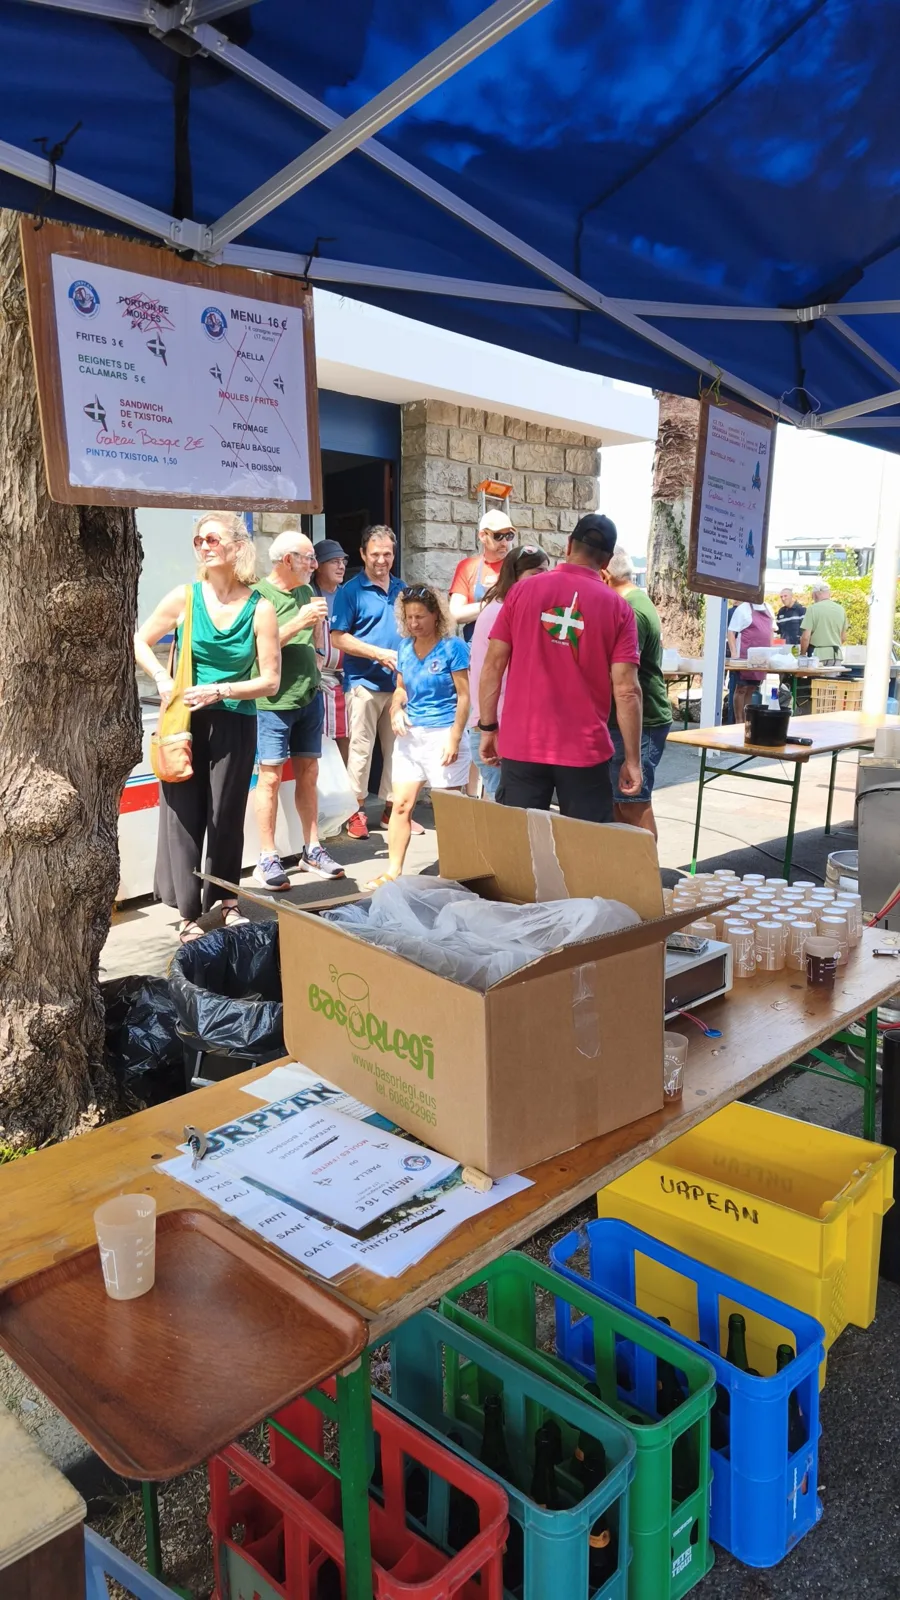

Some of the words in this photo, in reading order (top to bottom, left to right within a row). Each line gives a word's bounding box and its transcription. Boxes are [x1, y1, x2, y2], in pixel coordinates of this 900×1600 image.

[118, 296, 156, 311] PORTION
[157, 305, 170, 314] DE
[126, 308, 161, 323] MOULES
[230, 308, 262, 324] MENU
[268, 317, 279, 328] 16
[281, 320, 288, 330] €
[76, 331, 107, 345] FRITES
[112, 338, 117, 346] 3
[118, 340, 124, 348] €
[78, 354, 122, 369] BEIGNETS
[124, 362, 136, 371] DE
[236, 350, 265, 362] PAELLA
[79, 365, 128, 380] CALAMARS
[140, 376, 146, 384] €
[120, 399, 164, 412] SANDWICH
[218, 390, 249, 402] MOULES
[254, 396, 279, 407] FRITES
[120, 410, 131, 418] DE
[134, 412, 173, 424] TXISTORA
[232, 422, 268, 434] FROMAGE
[136, 428, 180, 454] Basque
[221, 440, 250, 451] GATEAU
[252, 444, 280, 454] BASQUE
[86, 448, 117, 458] PINTXO
[120, 452, 159, 463] TXISTORA
[163, 457, 178, 465] 1,50
[221, 460, 238, 468] PAIN
[251, 463, 282, 473] BOISSON
[352, 1052, 437, 1110] www.basorlegi.eus
[376, 1079, 388, 1098] tel.
[389, 1088, 437, 1127] 608622965
[308, 1118, 324, 1128] PAIN
[309, 1124, 336, 1142] GATEAU
[266, 1134, 298, 1154] BOISSON
[340, 1140, 368, 1158] MOULES
[209, 1148, 234, 1160] CLUB
[312, 1158, 337, 1175] FRITES
[354, 1164, 381, 1181] PAELLA
[382, 1176, 414, 1196] MENU
[365, 1197, 379, 1207] 16
[660, 1175, 759, 1224] URPEAN
[360, 1232, 398, 1254] PINTXO
